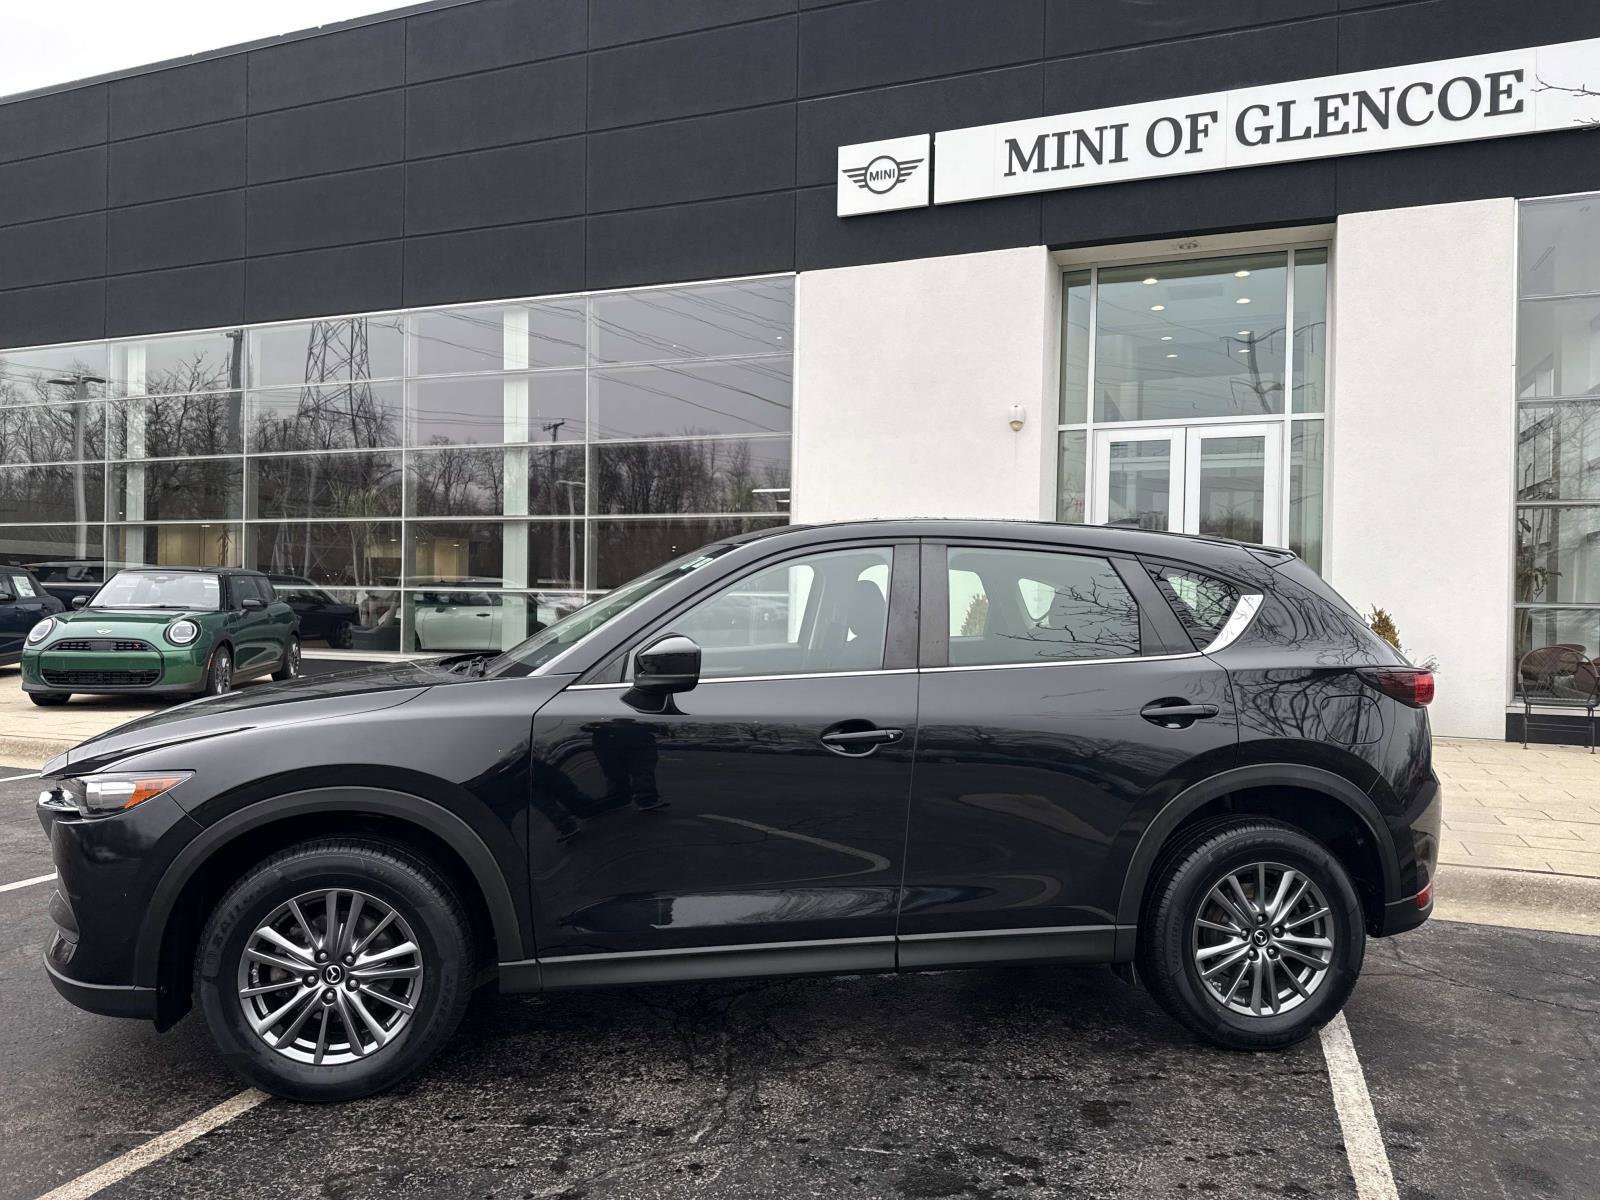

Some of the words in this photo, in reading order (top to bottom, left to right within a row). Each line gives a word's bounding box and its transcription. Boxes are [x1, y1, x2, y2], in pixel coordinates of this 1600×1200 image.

[1003, 122, 1129, 177] MINI
[1145, 110, 1218, 158] OF
[1235, 68, 1524, 147] GLENCOE
[869, 168, 896, 182] MINI
